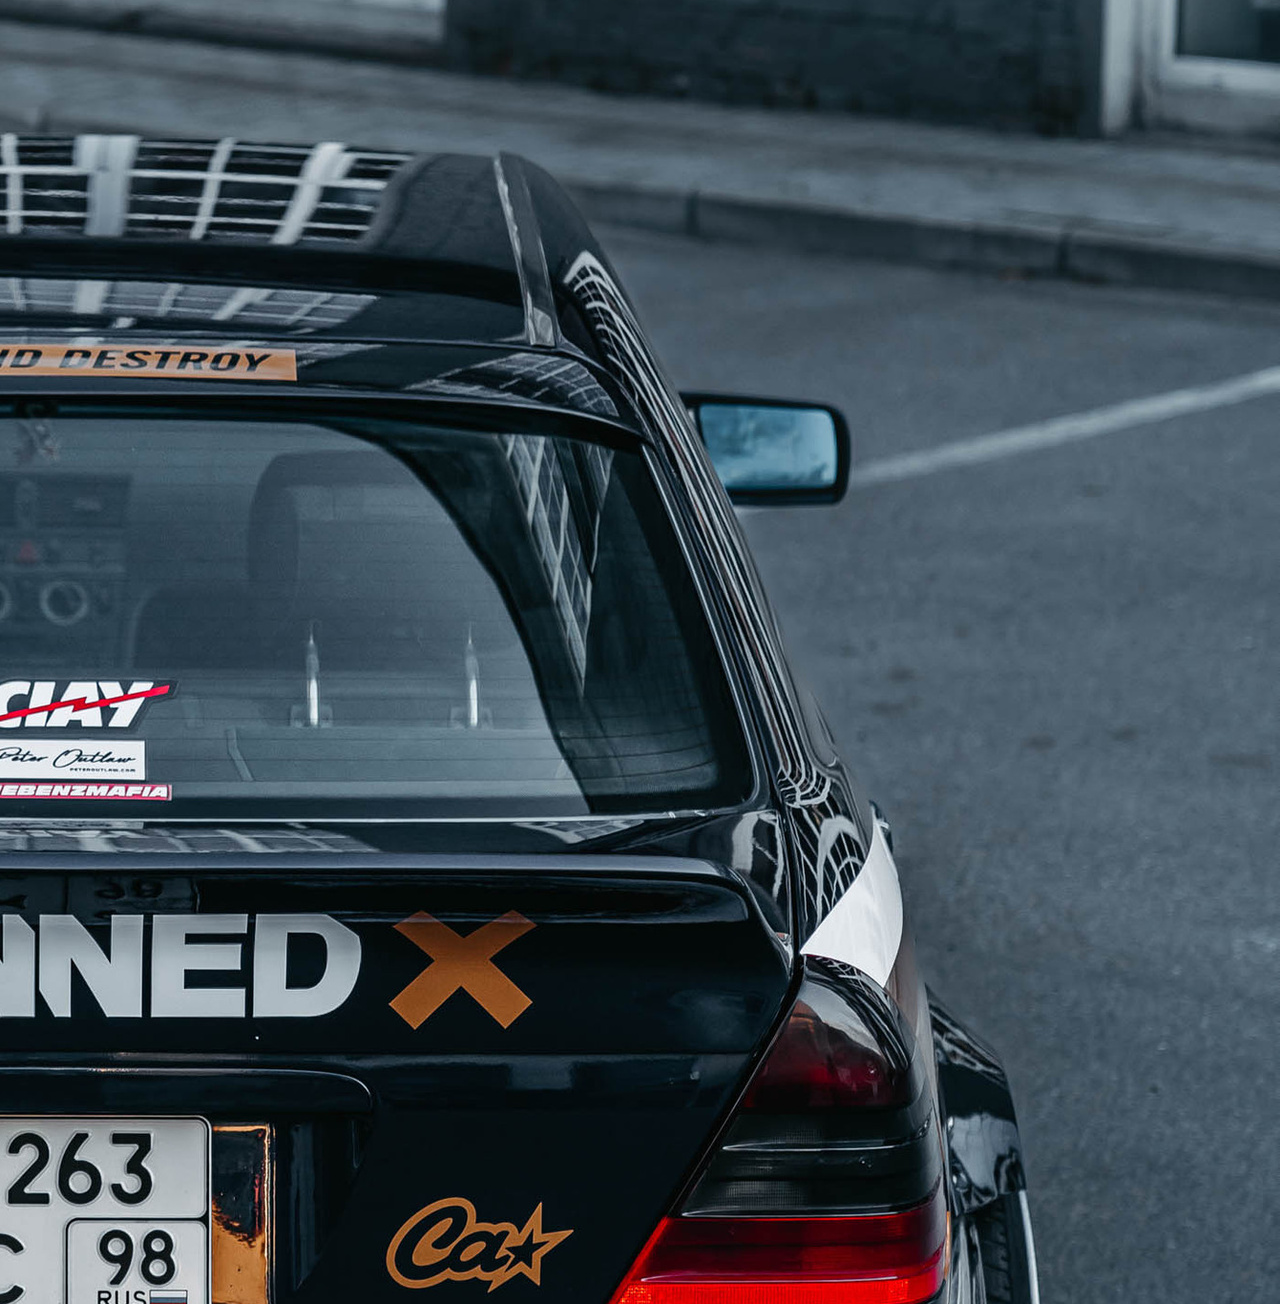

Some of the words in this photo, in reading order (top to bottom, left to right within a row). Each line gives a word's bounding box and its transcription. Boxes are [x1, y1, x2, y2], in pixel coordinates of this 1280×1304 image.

[58, 348, 273, 373] DESTROY
[53, 748, 136, 768] Outlaw
[7, 1131, 154, 1205] 263
[98, 1229, 176, 1286] 98
